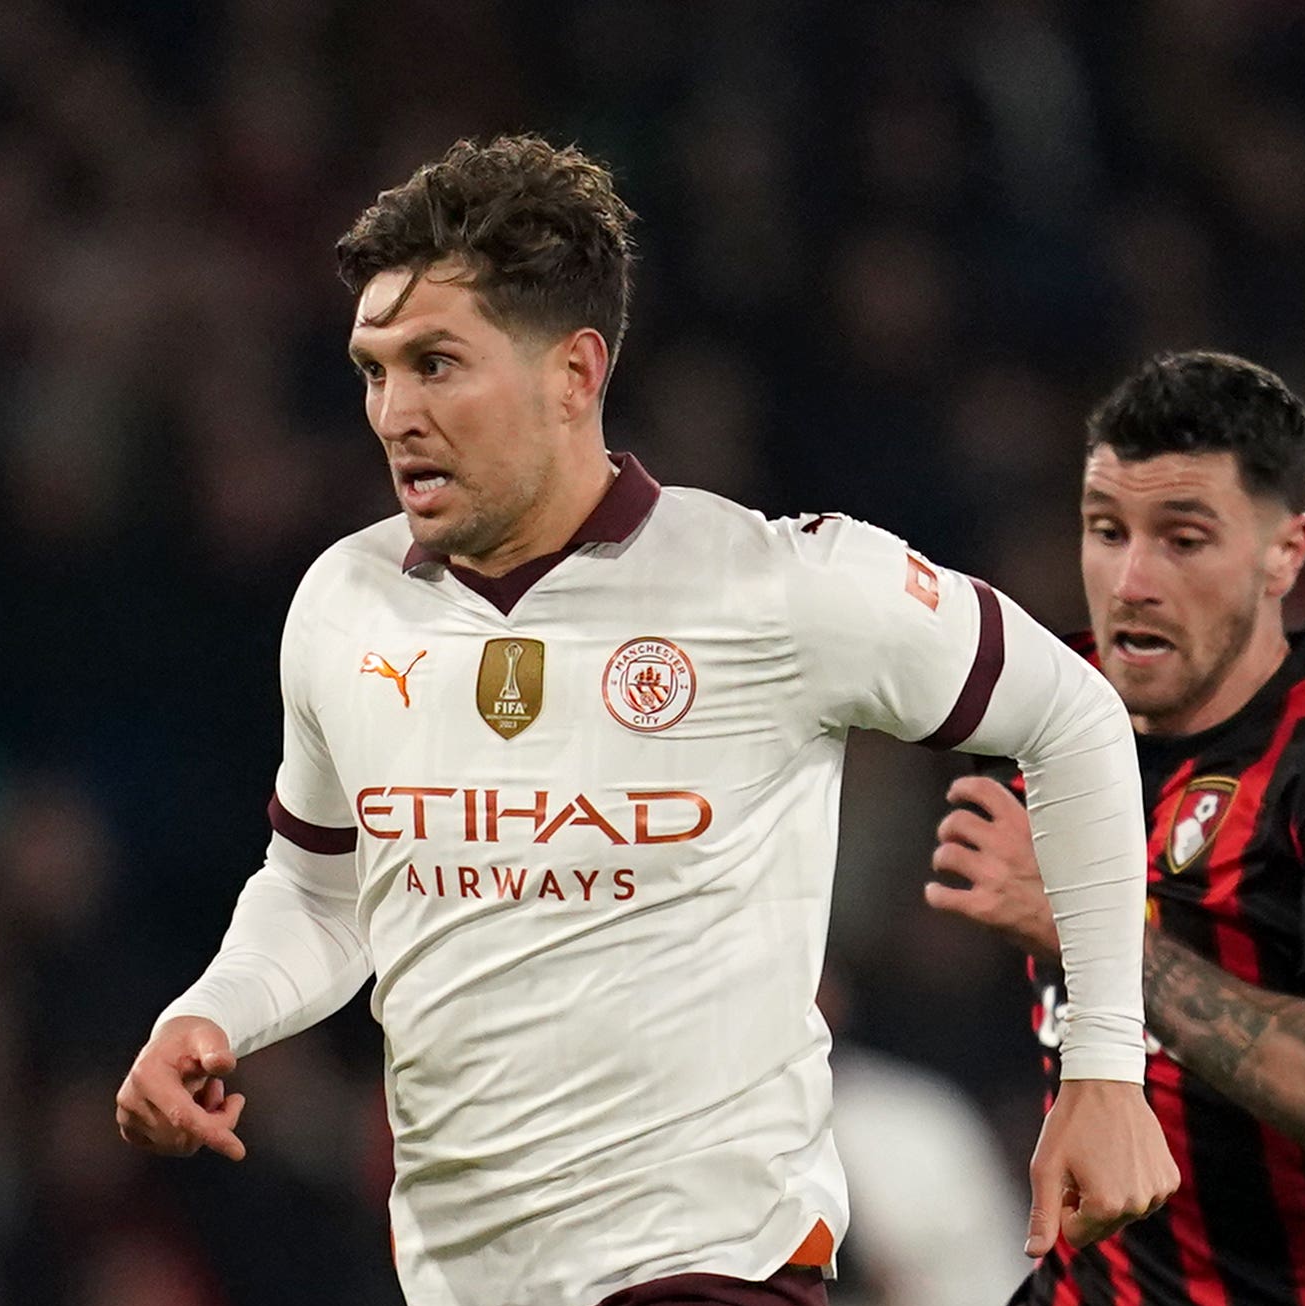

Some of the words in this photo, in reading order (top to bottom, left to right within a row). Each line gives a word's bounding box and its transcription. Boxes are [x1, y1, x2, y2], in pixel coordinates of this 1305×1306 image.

[615, 645, 687, 676] MANCHESTER
[494, 701, 526, 715] FIFA
[633, 715, 660, 725] CITY
[356, 786, 713, 845] ETIHAD
[406, 863, 636, 901] AIRWAYS
